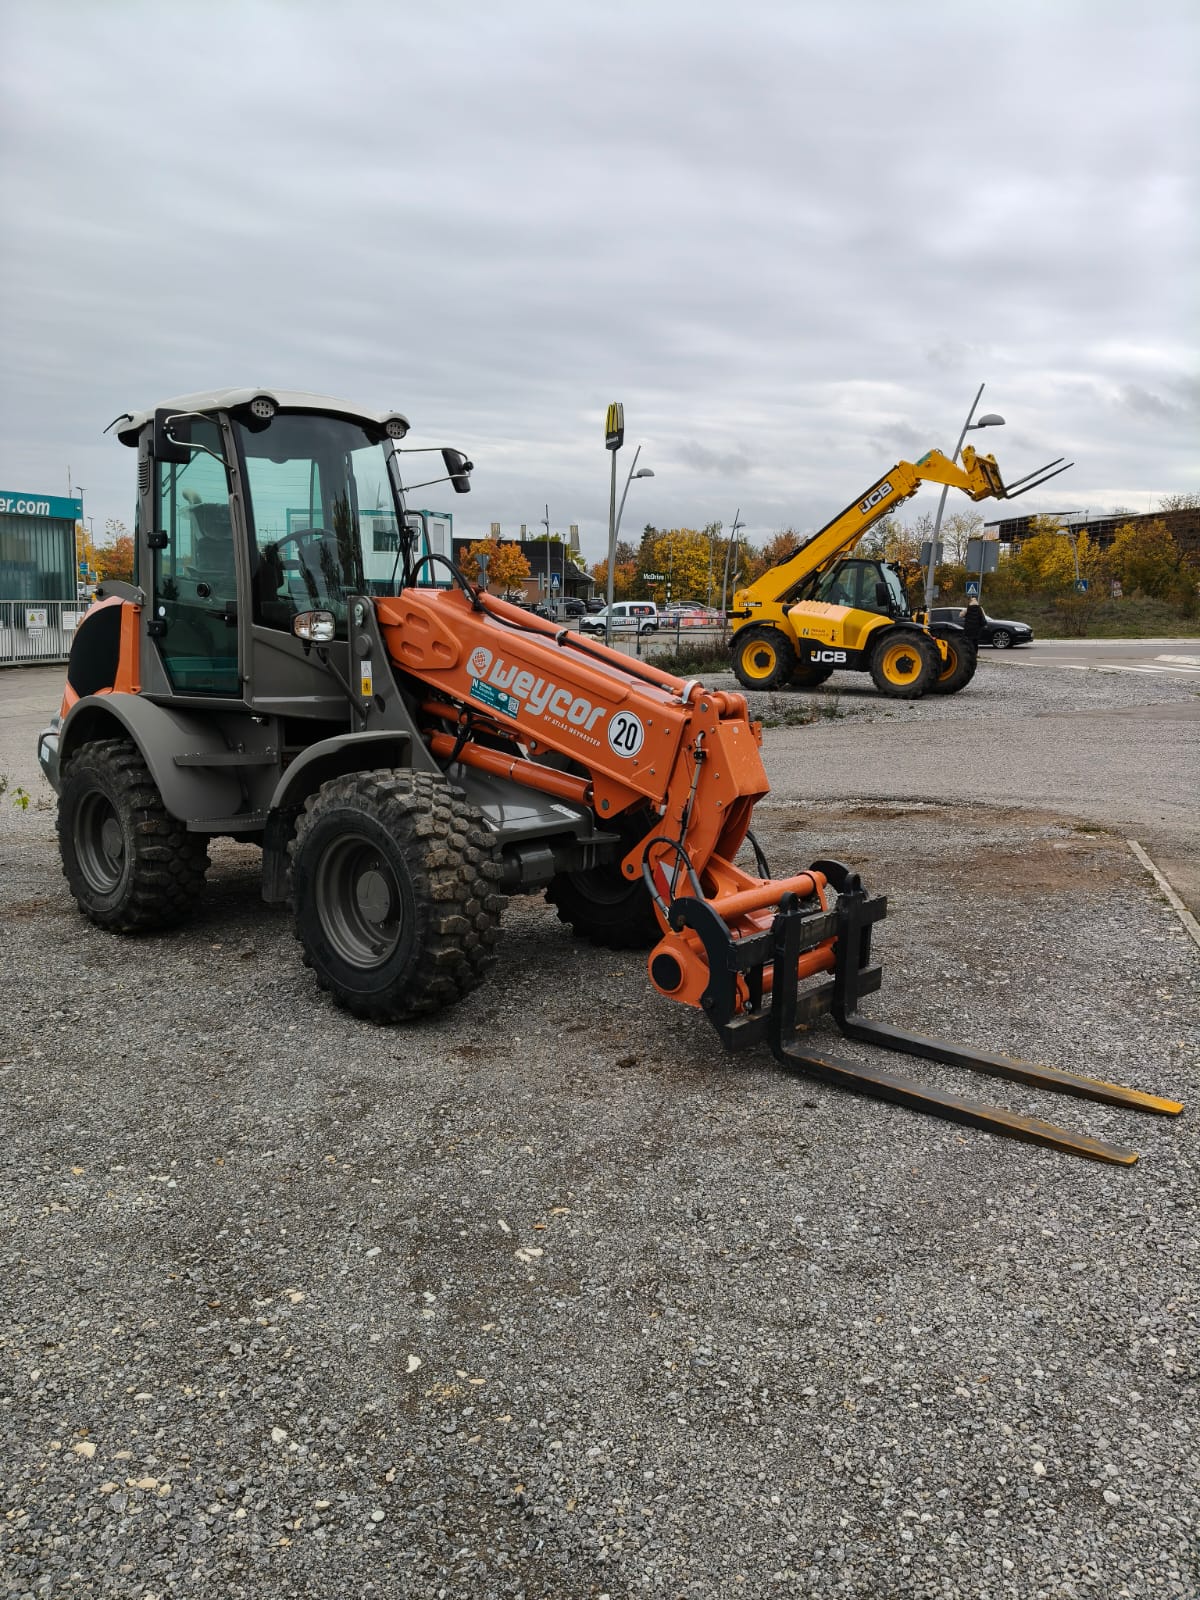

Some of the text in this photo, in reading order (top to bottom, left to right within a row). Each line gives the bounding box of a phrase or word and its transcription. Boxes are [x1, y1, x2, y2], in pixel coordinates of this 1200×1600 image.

[860, 482, 893, 513] JCB
[810, 650, 847, 663] JCB
[487, 658, 607, 732] weycor
[612, 717, 638, 751] 20
